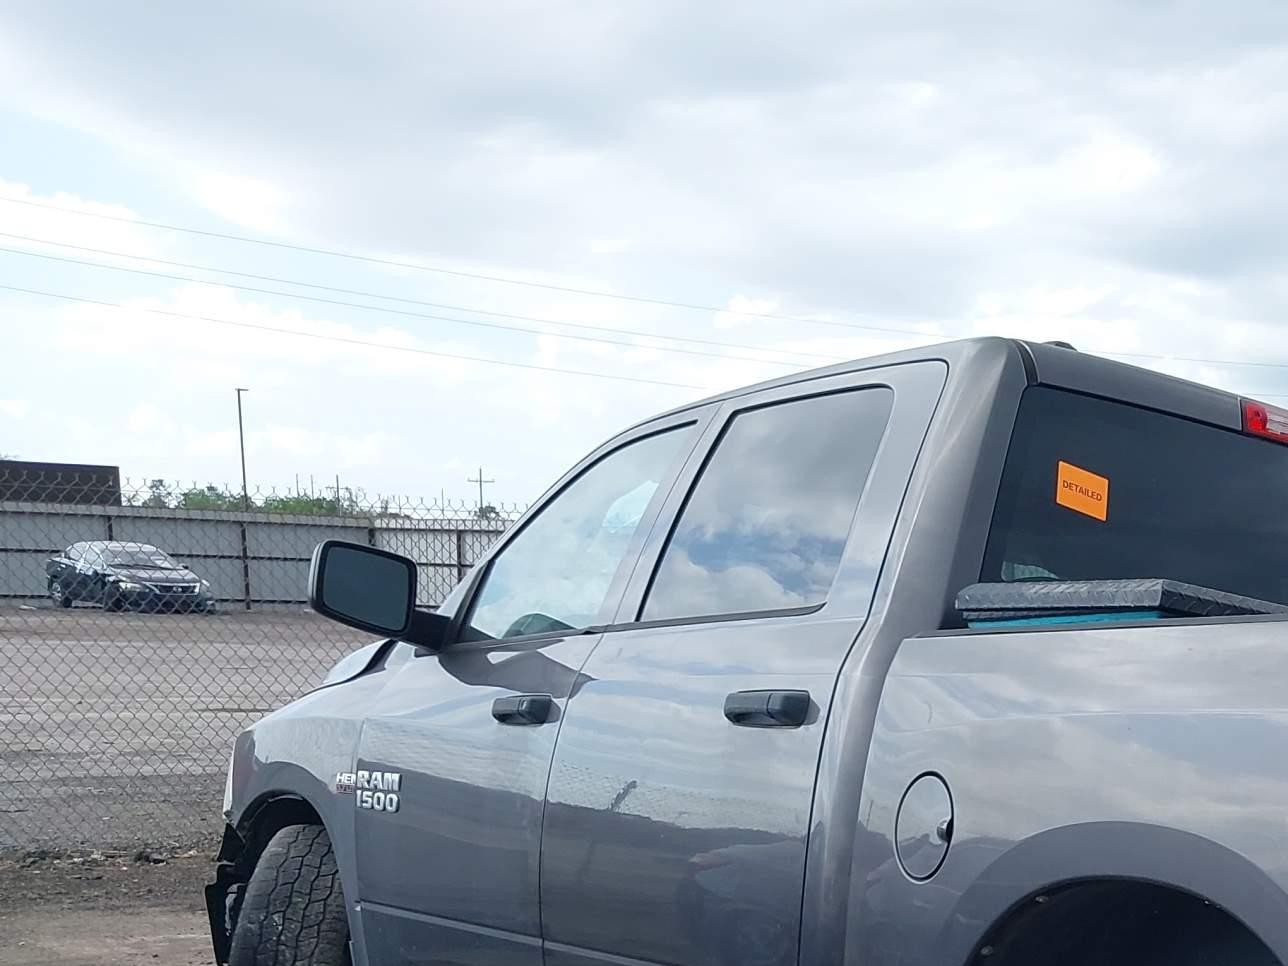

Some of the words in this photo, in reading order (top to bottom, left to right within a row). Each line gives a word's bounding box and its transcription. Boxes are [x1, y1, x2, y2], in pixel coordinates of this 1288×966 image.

[1062, 479, 1103, 502] DETAILED
[356, 770, 402, 791] RAM
[355, 789, 400, 813] 1500
